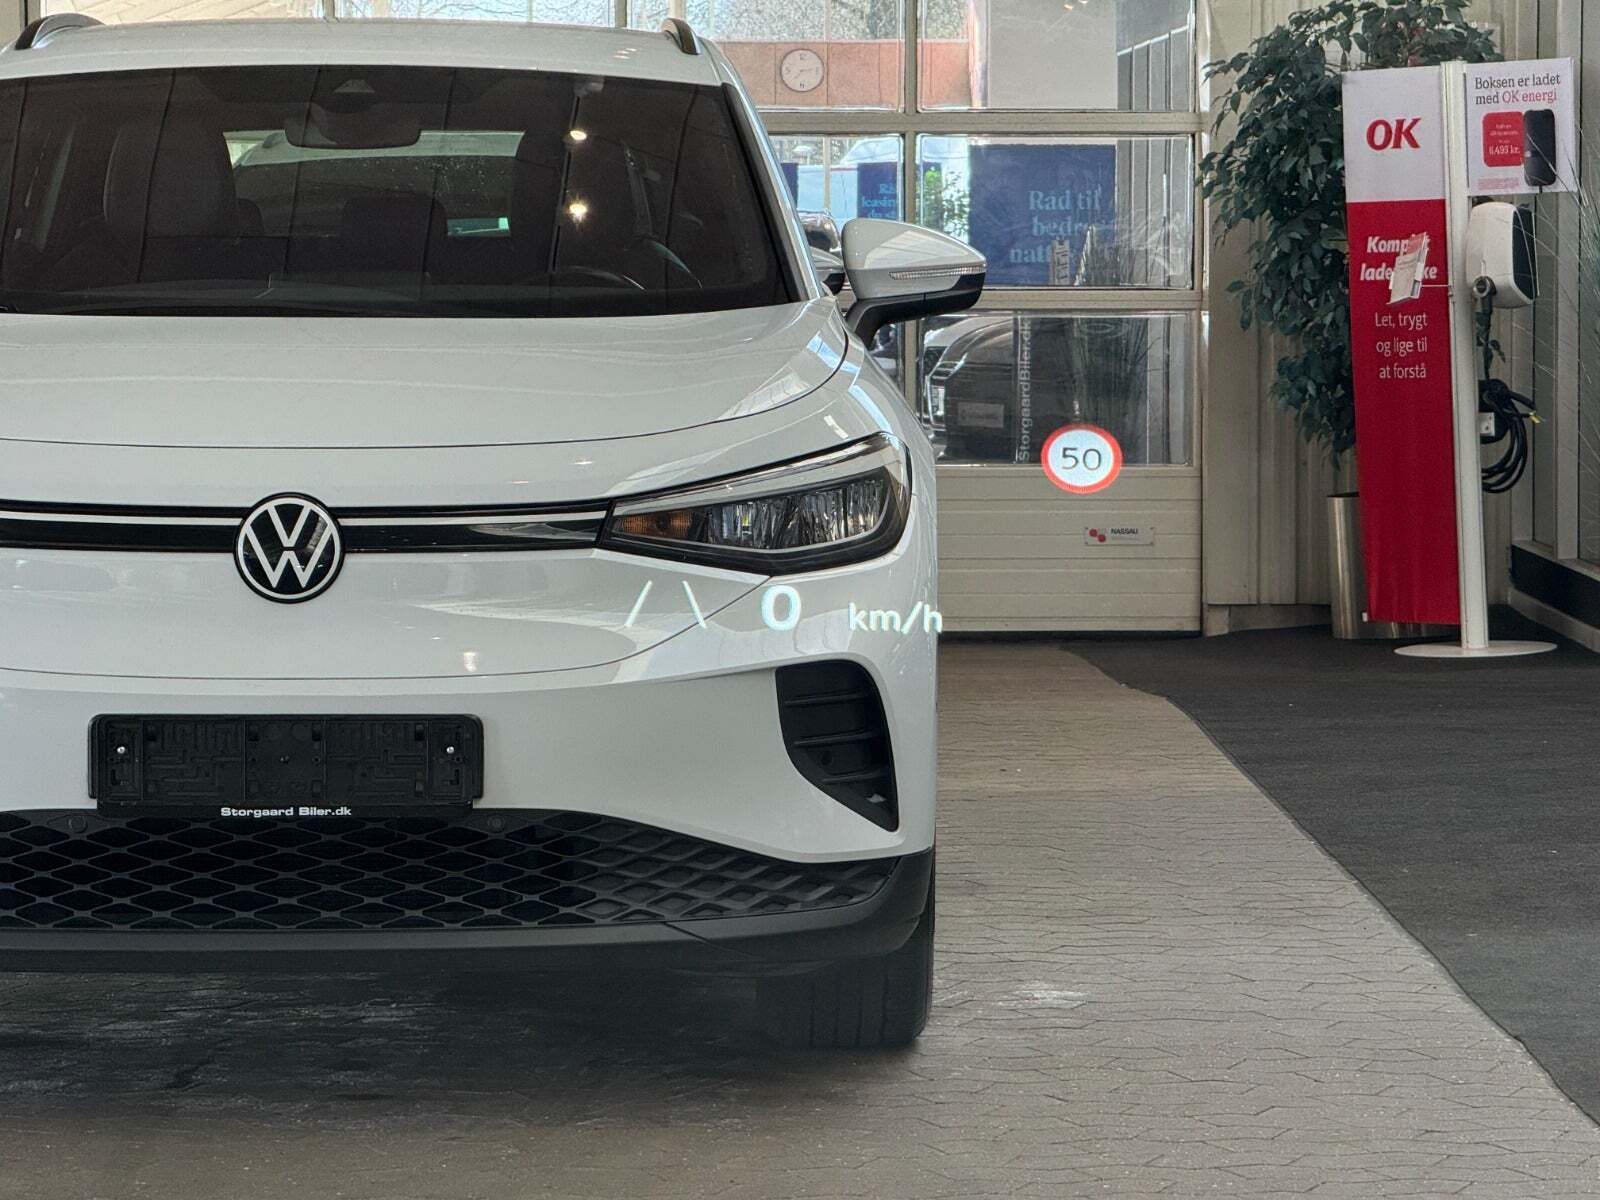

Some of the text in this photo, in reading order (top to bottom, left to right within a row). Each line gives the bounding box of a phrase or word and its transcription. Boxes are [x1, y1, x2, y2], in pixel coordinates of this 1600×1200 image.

[1475, 73, 1560, 90] Boksen er ladet
[1475, 88, 1557, 105] med OK energi
[1366, 117, 1422, 151] OK
[1374, 312, 1428, 331] Let, trygt
[1376, 336, 1428, 357] og lige til
[1379, 362, 1427, 379] at forstå
[1061, 446, 1102, 471] 50
[1110, 527, 1138, 535] NASSAU
[761, 584, 943, 635] 0 km/h
[220, 806, 352, 818] Storgaard Biler.dk
